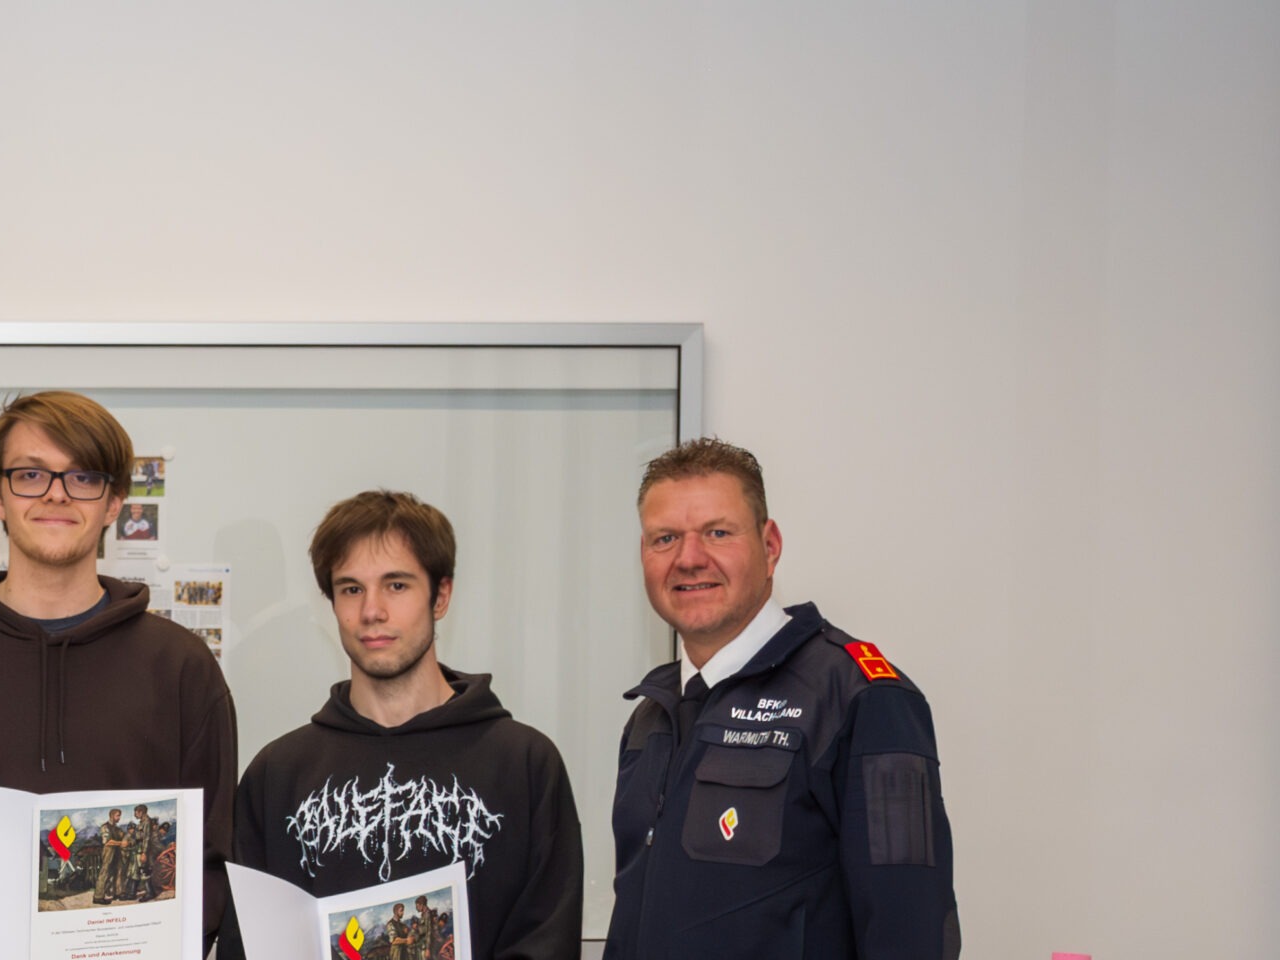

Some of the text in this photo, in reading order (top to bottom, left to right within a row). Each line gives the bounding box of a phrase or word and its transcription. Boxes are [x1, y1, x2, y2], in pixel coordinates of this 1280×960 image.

[723, 729, 790, 747] WARMUTH TH.
[101, 949, 141, 957] Anerkennung
